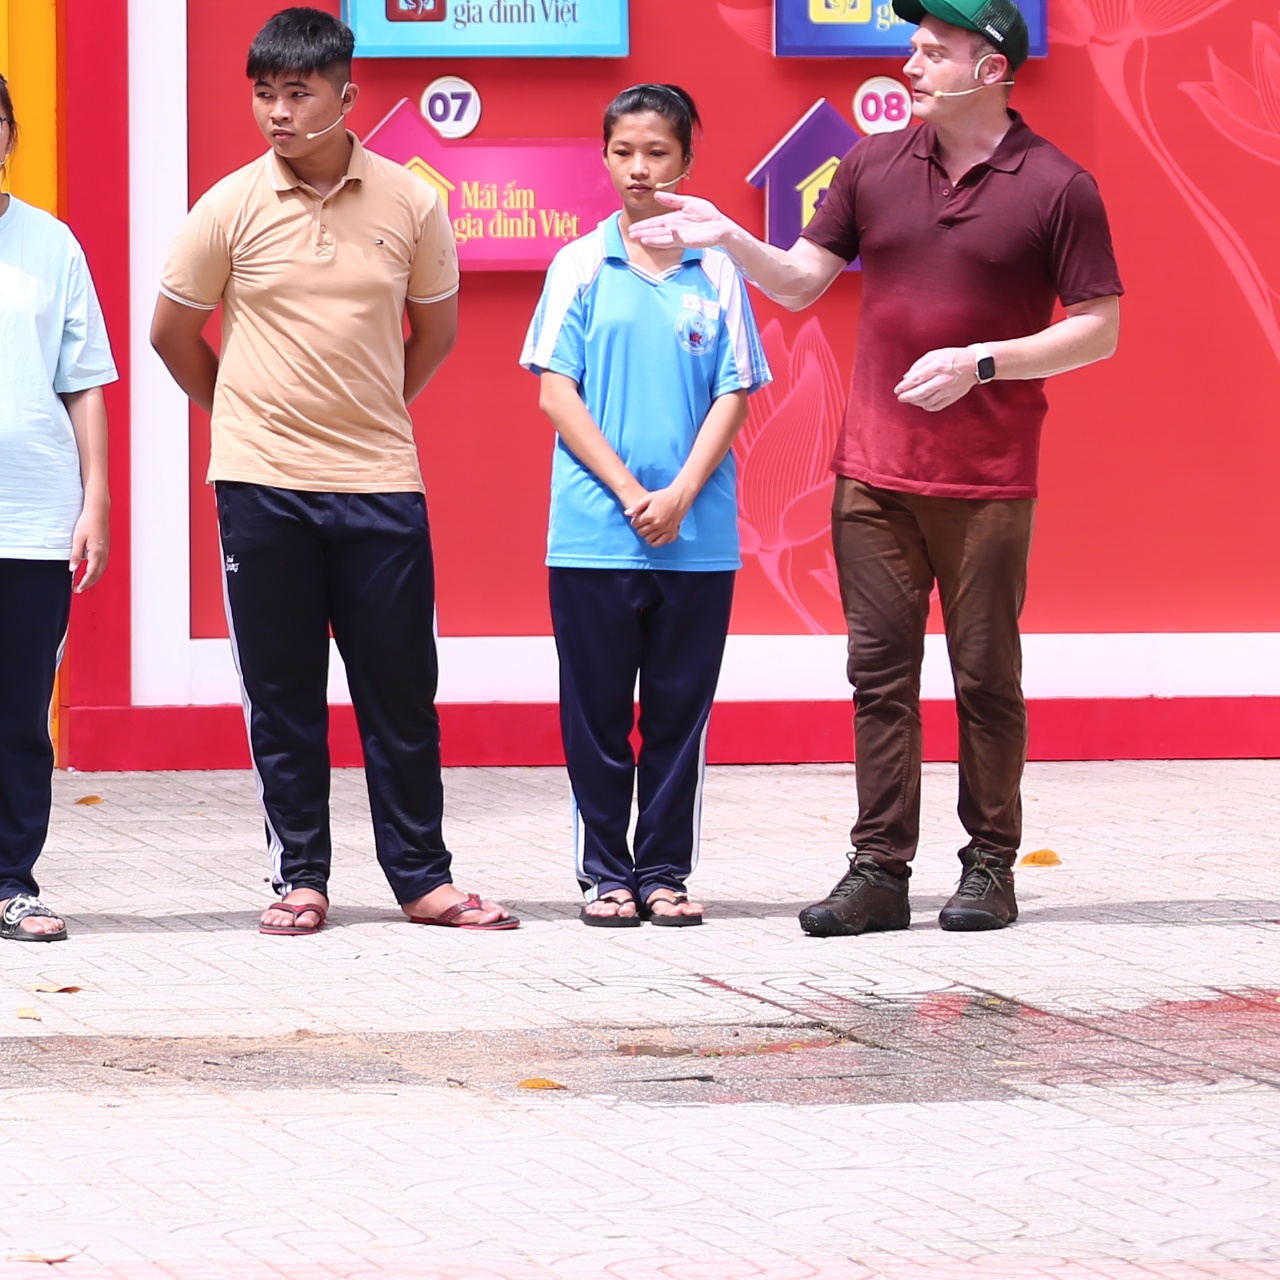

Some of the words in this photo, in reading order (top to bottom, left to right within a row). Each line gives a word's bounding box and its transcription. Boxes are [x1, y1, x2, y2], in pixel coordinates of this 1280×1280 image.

[453, 0, 483, 30] gia
[428, 91, 472, 122] 07
[861, 91, 907, 122] 08
[461, 180, 498, 209] Mái
[502, 179, 535, 209] ấm
[454, 212, 484, 245] gia
[489, 208, 537, 238] đình
[539, 208, 581, 243] Việt
